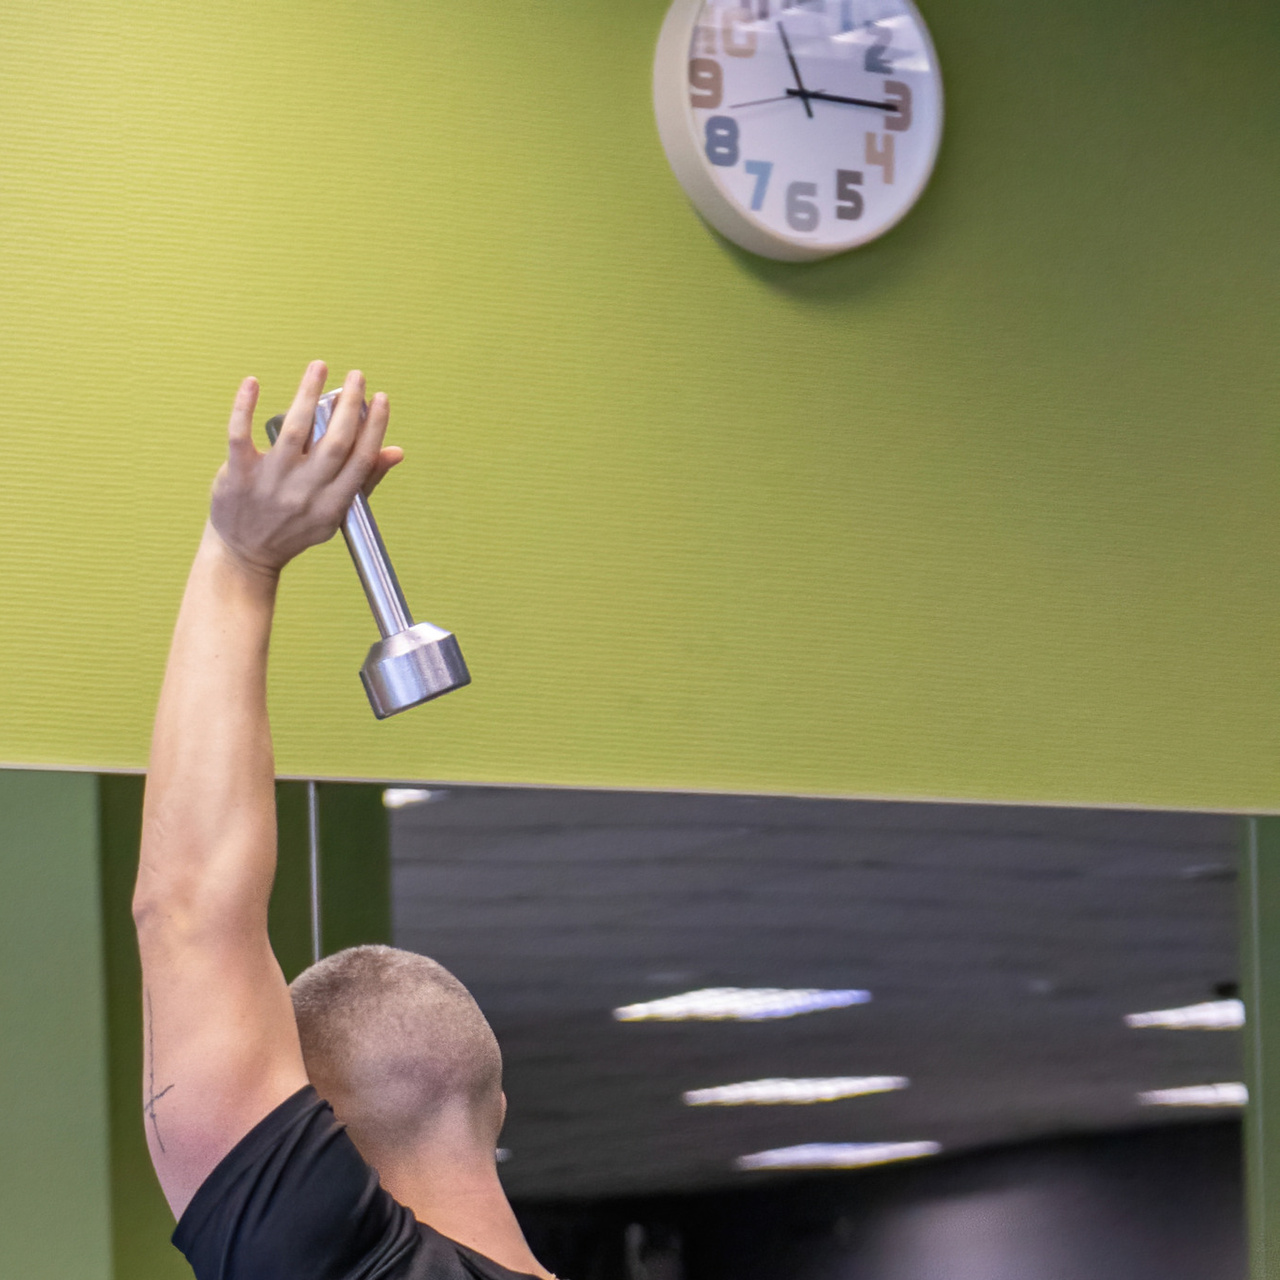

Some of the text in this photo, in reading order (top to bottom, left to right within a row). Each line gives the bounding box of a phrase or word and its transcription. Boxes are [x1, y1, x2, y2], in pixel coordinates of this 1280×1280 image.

[864, 20, 896, 75] 2
[688, 57, 724, 110] 9
[882, 79, 912, 132] 3
[704, 115, 740, 167] 8
[865, 132, 895, 185] 4
[744, 159, 774, 211] 7
[785, 181, 819, 232] 6
[835, 169, 863, 221] 5
